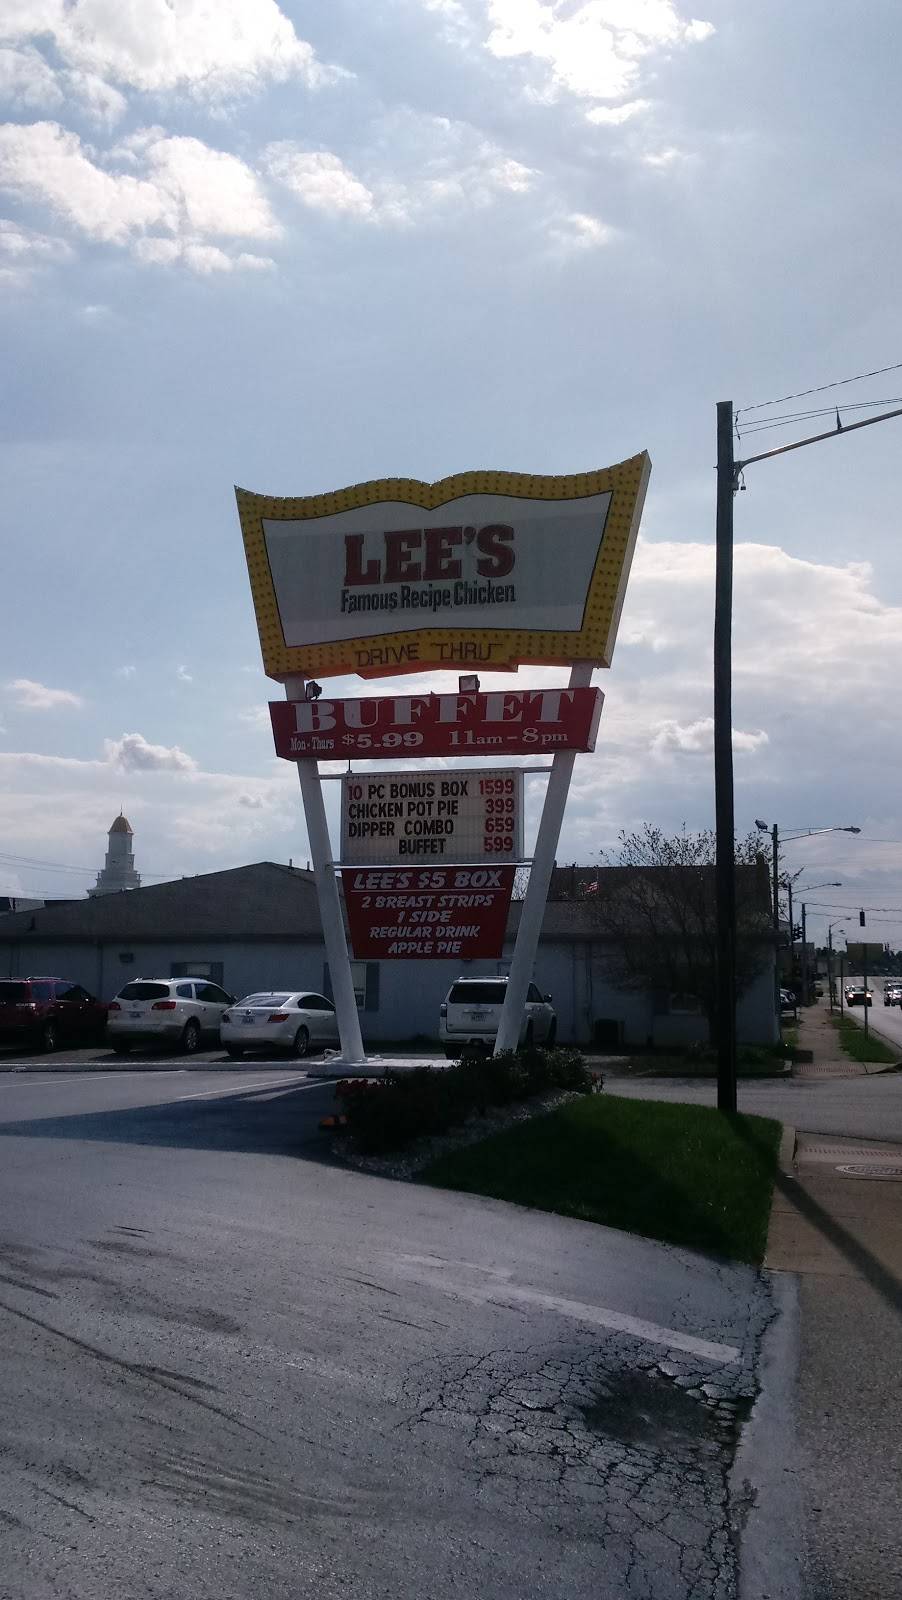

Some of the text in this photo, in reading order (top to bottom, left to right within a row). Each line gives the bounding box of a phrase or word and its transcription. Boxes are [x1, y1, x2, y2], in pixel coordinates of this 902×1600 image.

[344, 524, 515, 586] LEE'S
[341, 581, 516, 614] Famous Recipe Chicken
[355, 643, 504, 667] DRIVE THRU
[291, 690, 575, 734] BUFFET
[341, 732, 424, 749] $5.99
[348, 779, 515, 801] 10 PC BONUS BOX 1599
[348, 798, 515, 819] CHICKEN POT PIE 399
[348, 817, 515, 837] DIPPER COMBO 659
[398, 836, 513, 854] BUFFET 599
[353, 870, 502, 889] LEE'S $5 BOX
[361, 894, 495, 908] 2 BREAST STRIPS
[397, 910, 453, 923] 1 SIDE
[369, 925, 481, 938] REGULAR DRINK
[388, 941, 462, 954] APPLE PIE
